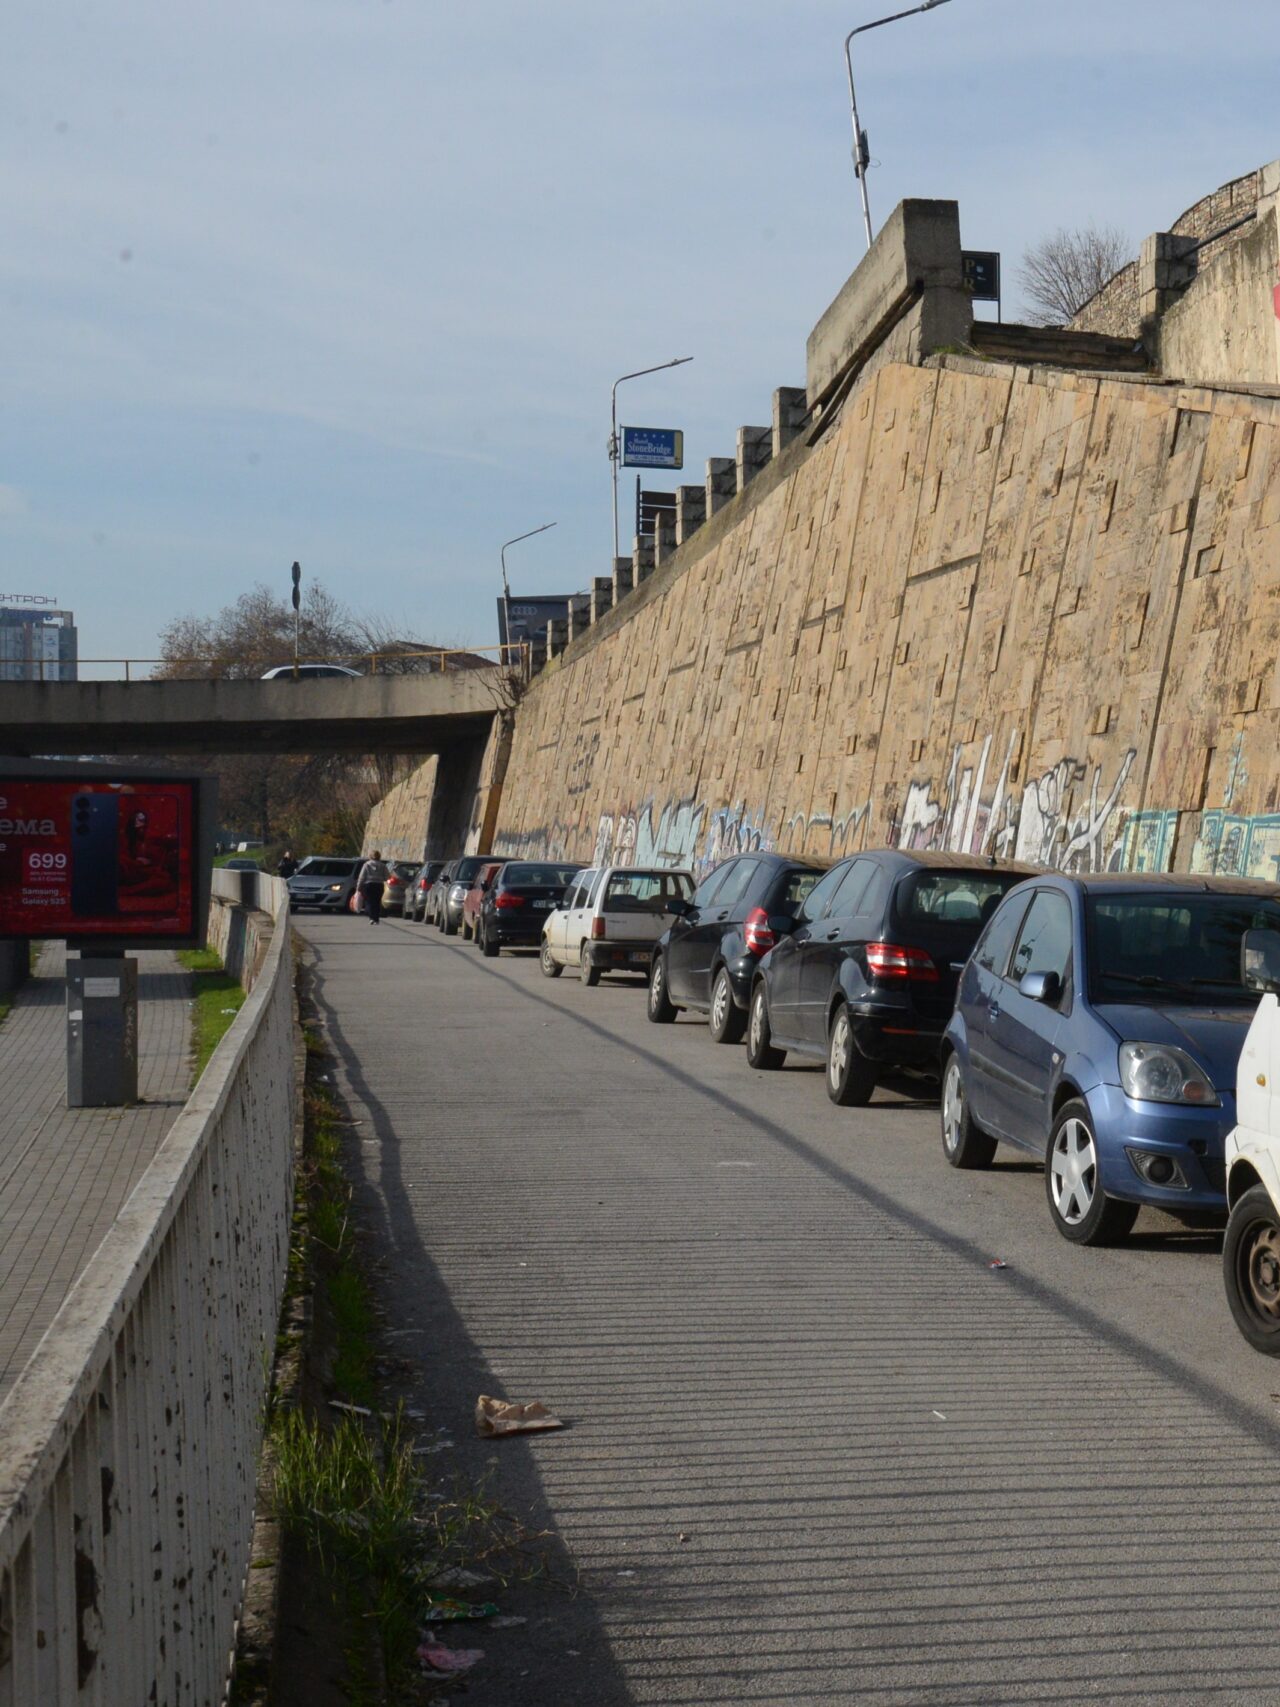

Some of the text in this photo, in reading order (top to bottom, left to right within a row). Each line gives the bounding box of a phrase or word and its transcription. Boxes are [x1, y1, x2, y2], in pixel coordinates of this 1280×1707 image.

[627, 441, 672, 455] StoneBridge
[28, 853, 67, 869] 699
[22, 888, 59, 897] Samsung
[22, 897, 48, 906] Galaxy
